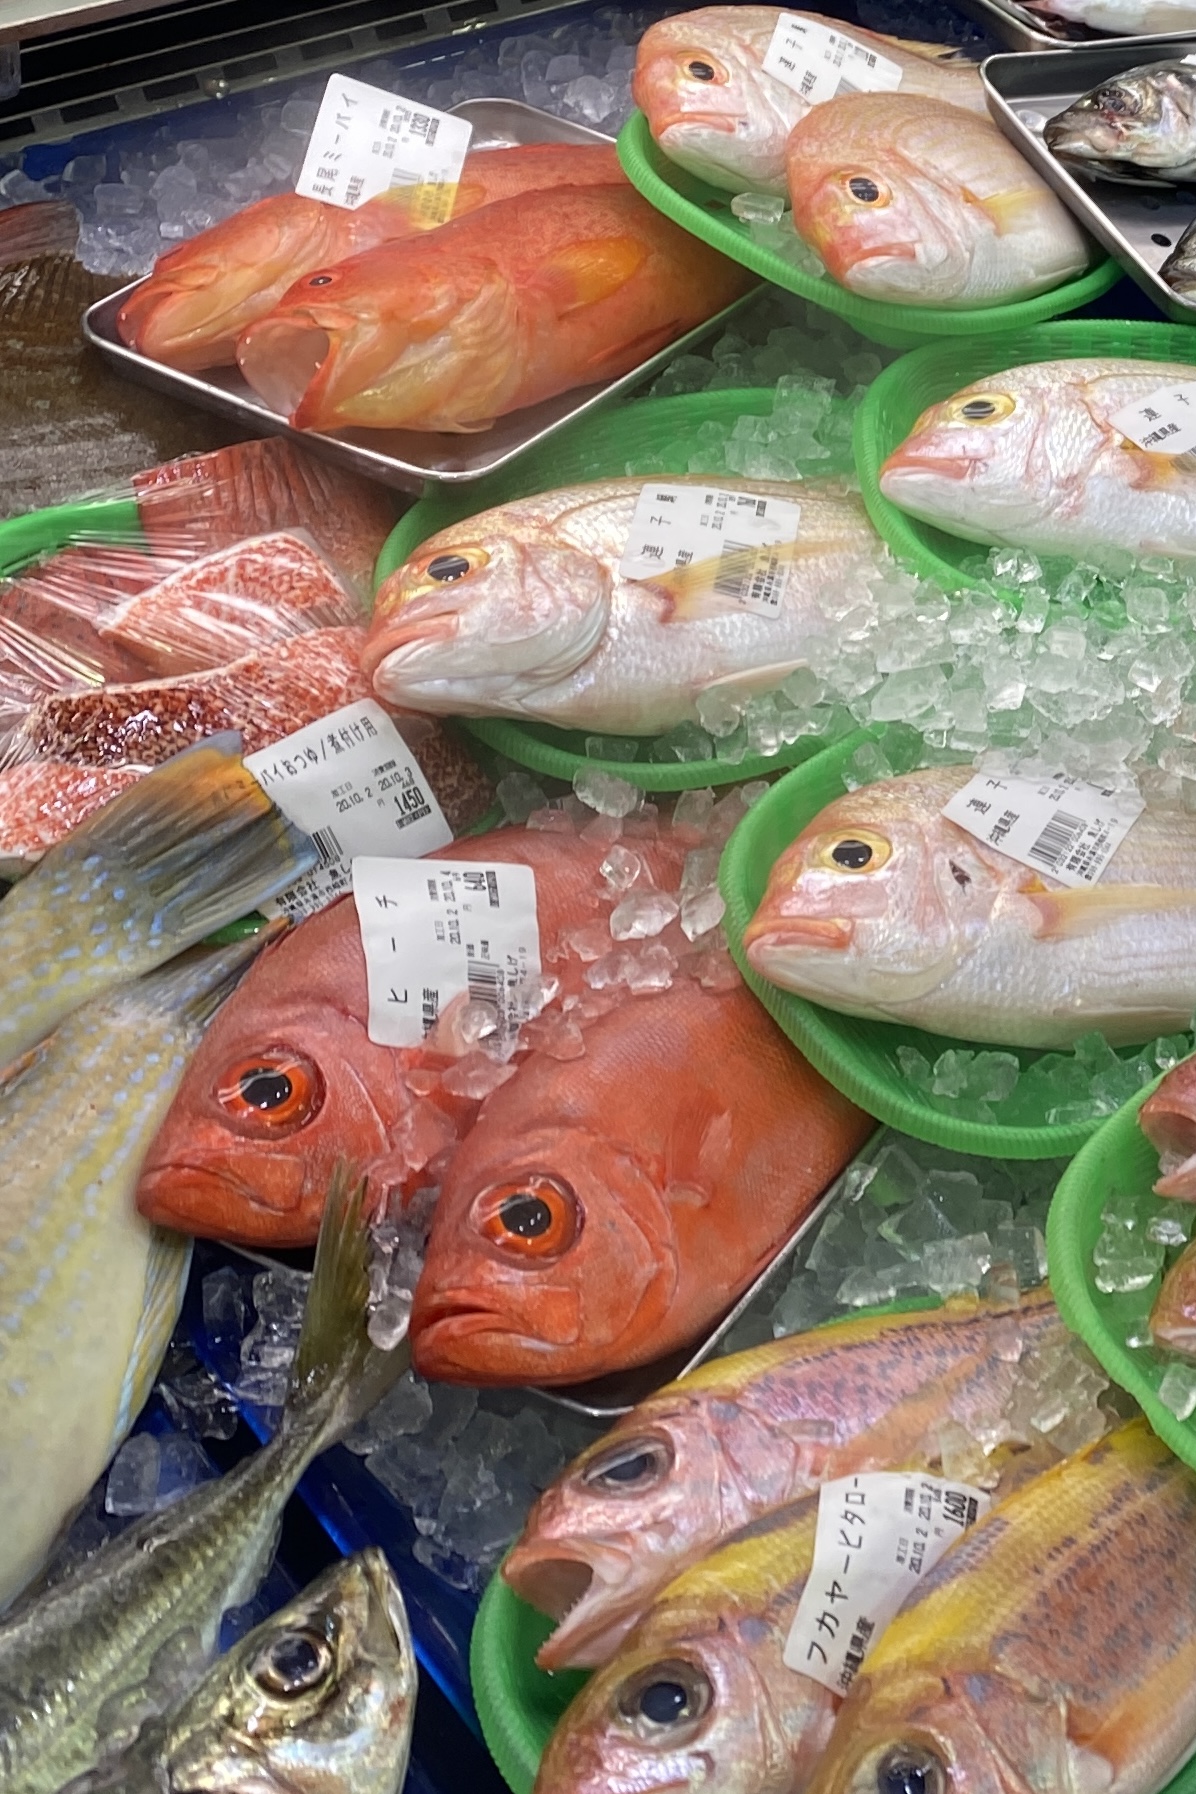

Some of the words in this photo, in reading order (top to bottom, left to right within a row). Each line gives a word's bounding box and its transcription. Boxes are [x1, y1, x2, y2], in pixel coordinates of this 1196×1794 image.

[392, 784, 426, 816] 1450
[274, 877, 319, 907] 有限会社
[463, 871, 486, 889] 640
[374, 893, 408, 1002] ヒーチ
[422, 987, 439, 1038] 縄県産
[941, 1489, 968, 1527] 1600
[836, 1615, 875, 1689] 沖縄県産
